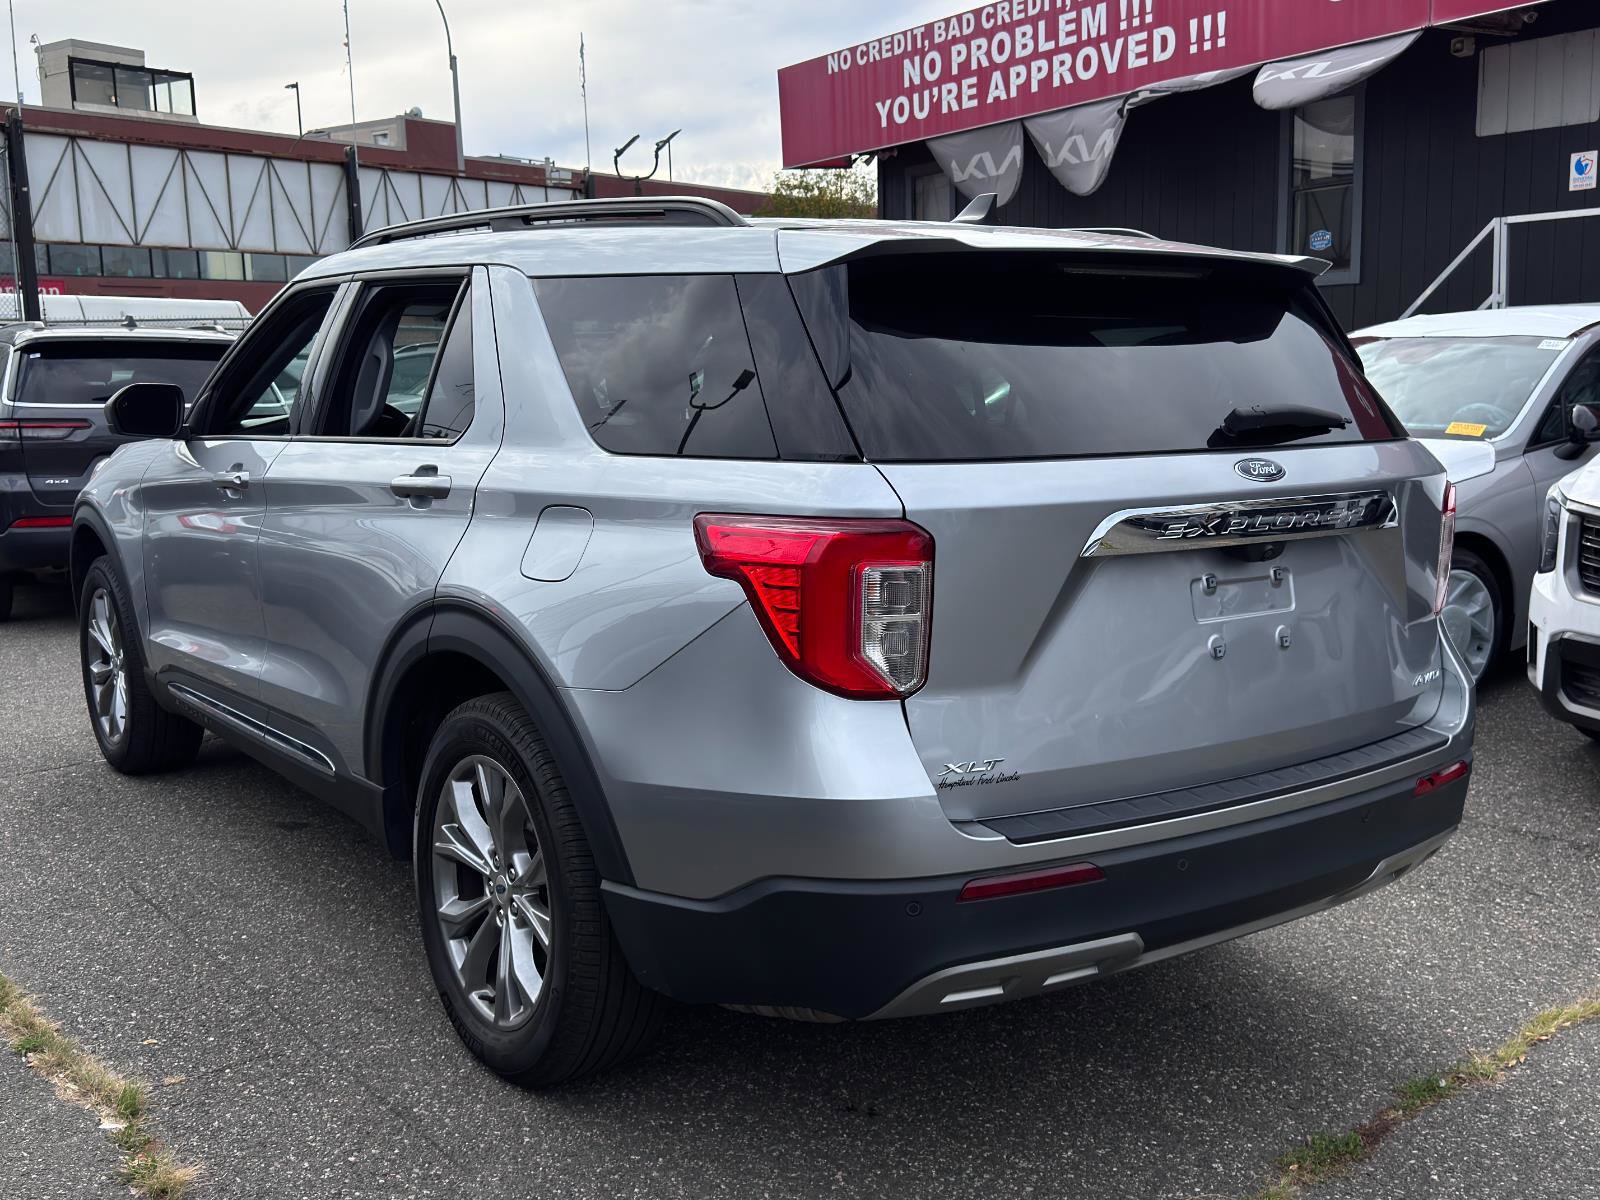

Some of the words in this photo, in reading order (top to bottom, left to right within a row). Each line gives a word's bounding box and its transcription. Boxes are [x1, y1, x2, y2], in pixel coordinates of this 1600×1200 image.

[827, 50, 852, 74] NO
[857, 26, 929, 66] CREDIT,
[934, 13, 975, 44] BAD
[903, 51, 942, 88] NO
[951, 2, 1107, 75] PROBLEM
[875, 76, 978, 128] YOU'RE
[986, 26, 1176, 104] APPROVED
[1189, 10, 1226, 54] !!!
[1249, 461, 1277, 475] Ford
[1156, 503, 1366, 540] EXPLORER
[938, 757, 1006, 776] XLT
[977, 773, 994, 786] Ford
[996, 770, 1021, 784] Lincoln
